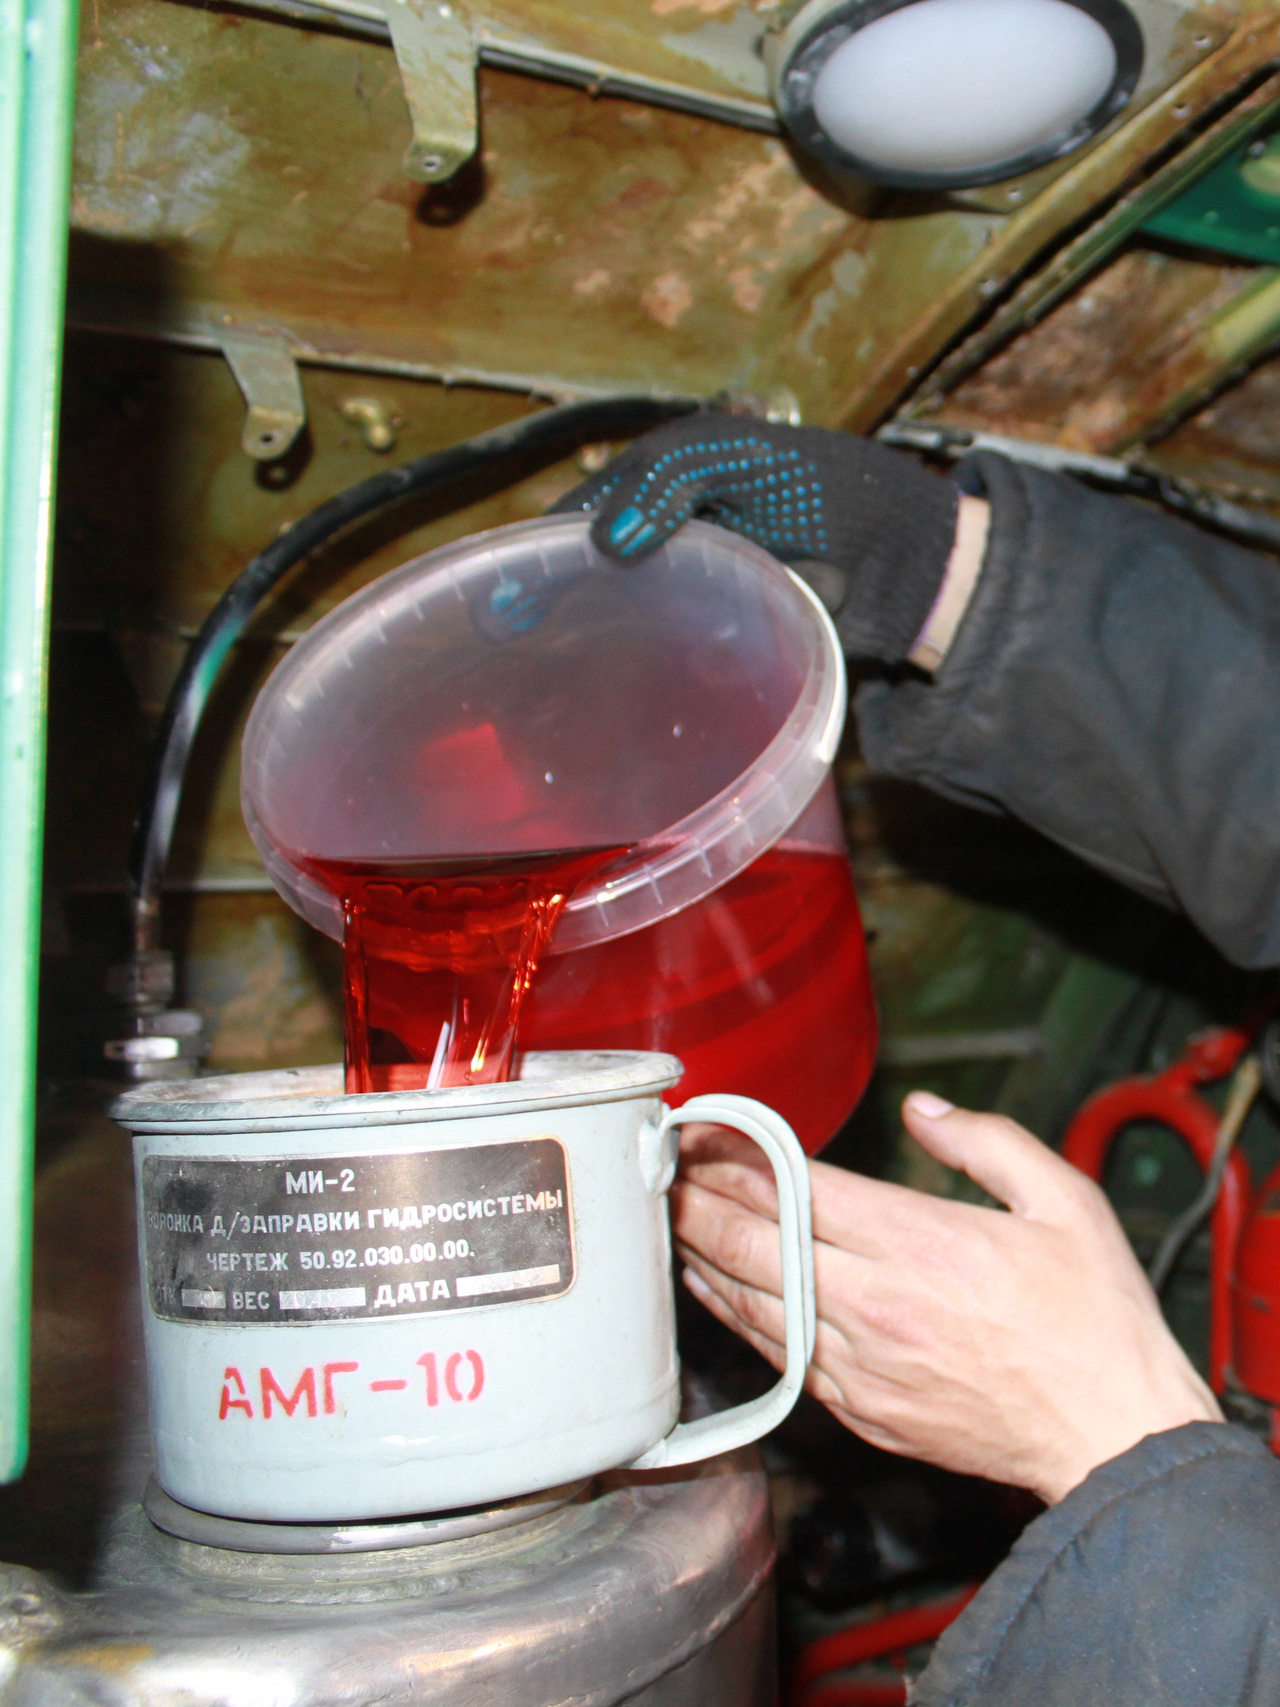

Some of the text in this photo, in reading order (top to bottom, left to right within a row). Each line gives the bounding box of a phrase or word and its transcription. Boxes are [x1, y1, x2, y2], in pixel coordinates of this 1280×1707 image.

[285, 1168, 356, 1195] МИ-2
[147, 1210, 204, 1234] ВОРОНКА
[367, 1189, 564, 1230] ГИДРОСИСТЕМЫ
[206, 1239, 475, 1272] ЧЕРТЕЖ 50.92.030.00.00.
[232, 1291, 271, 1310] ВЕС
[373, 1279, 451, 1309] ДАТА
[218, 1350, 485, 1420] АМГ-10
